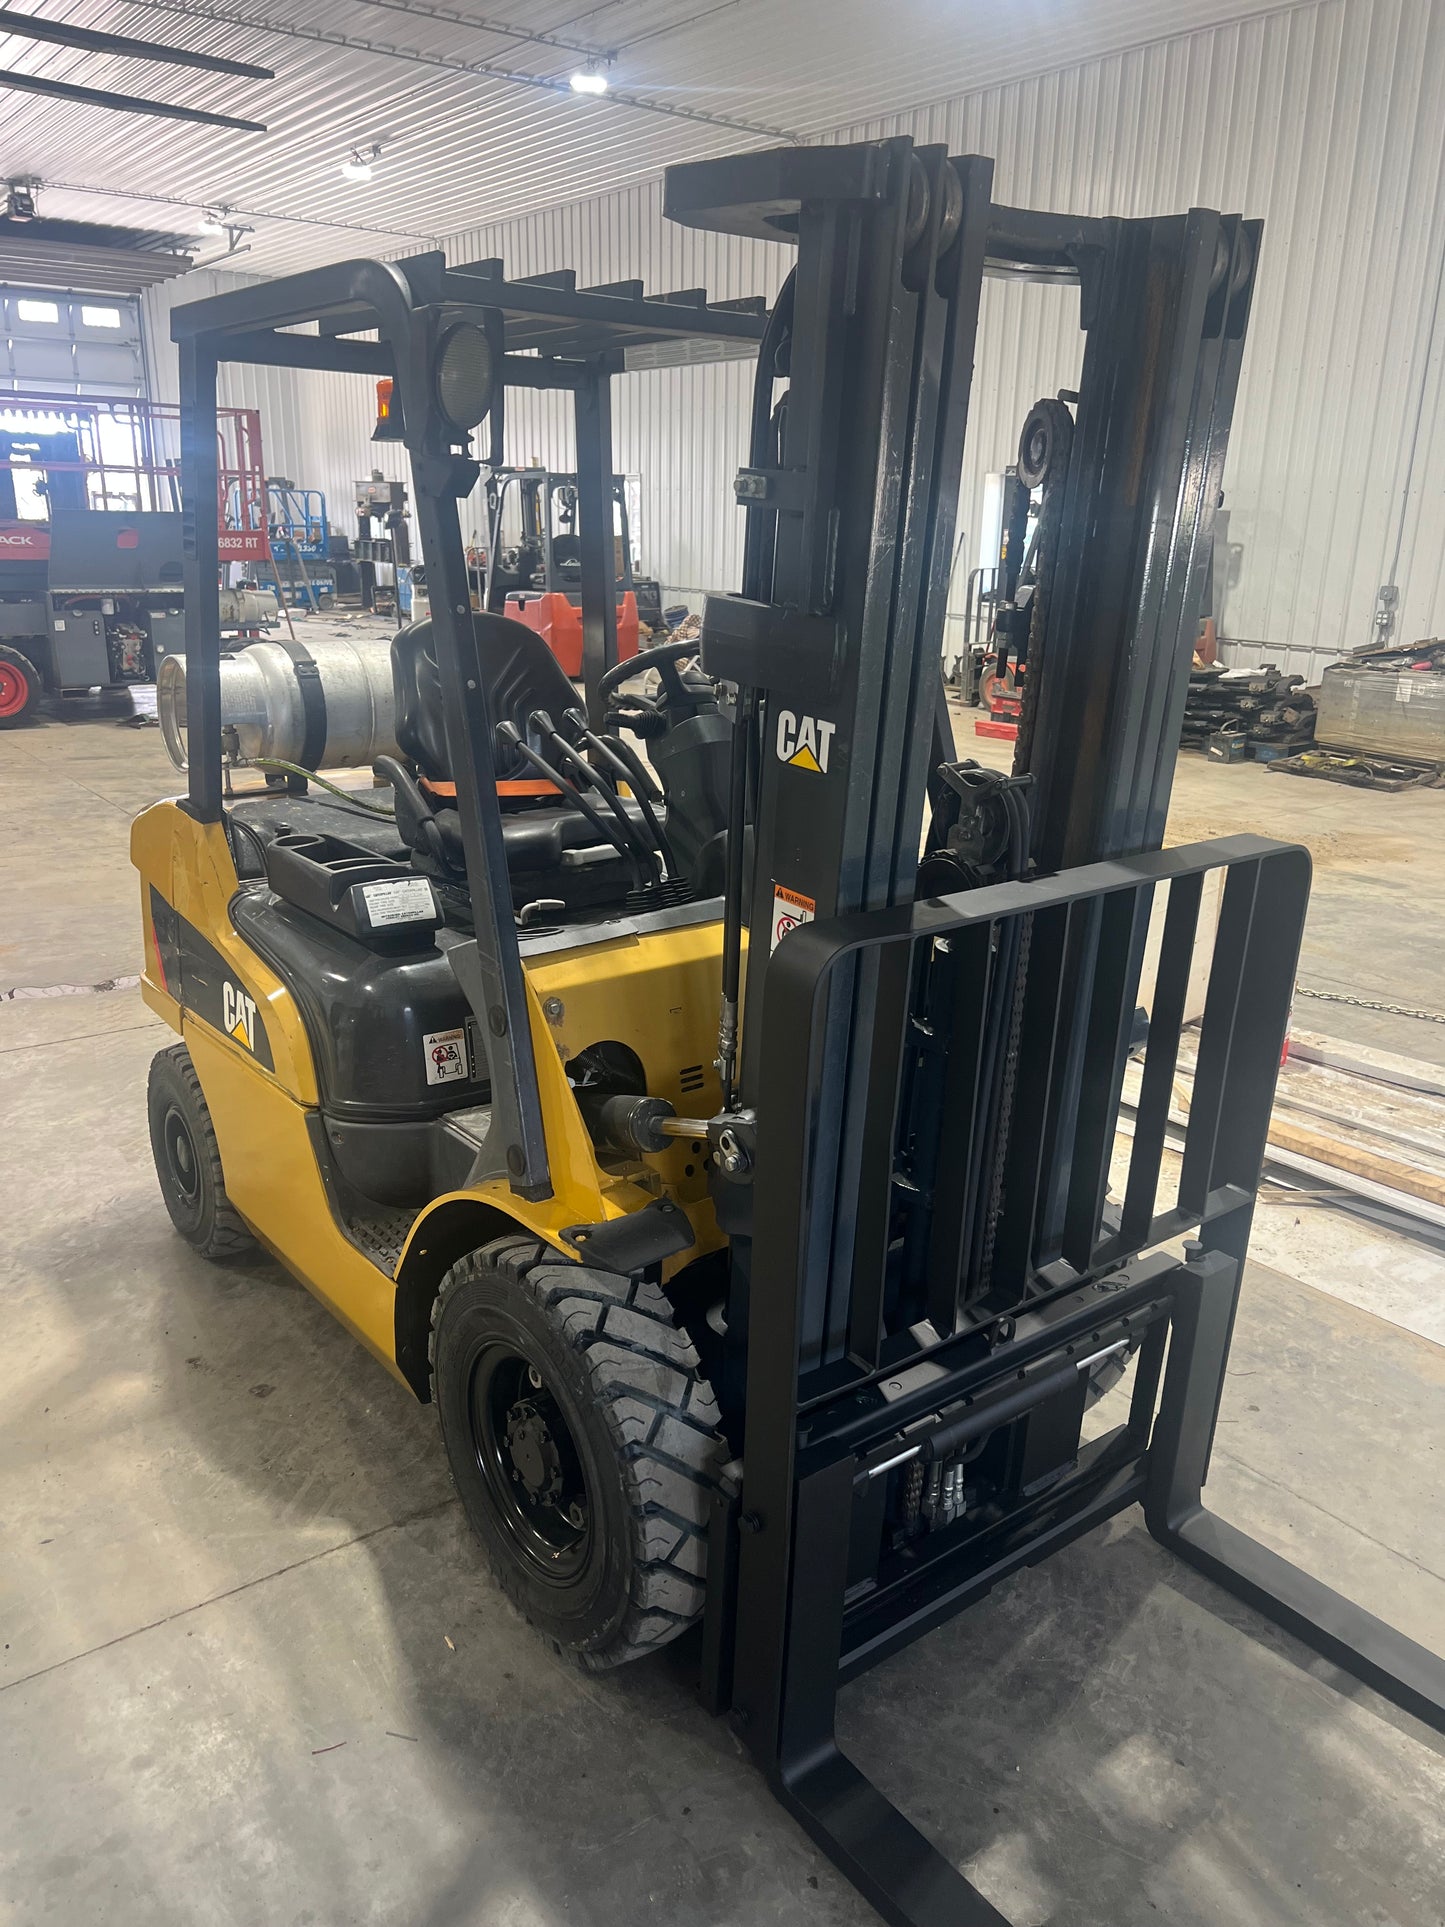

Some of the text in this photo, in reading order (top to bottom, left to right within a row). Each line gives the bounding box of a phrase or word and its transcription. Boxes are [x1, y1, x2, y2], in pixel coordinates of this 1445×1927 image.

[245, 537, 258, 549] RT
[776, 710, 836, 774] CAT
[785, 892, 815, 911] WARNING
[223, 981, 257, 1052] CAT
